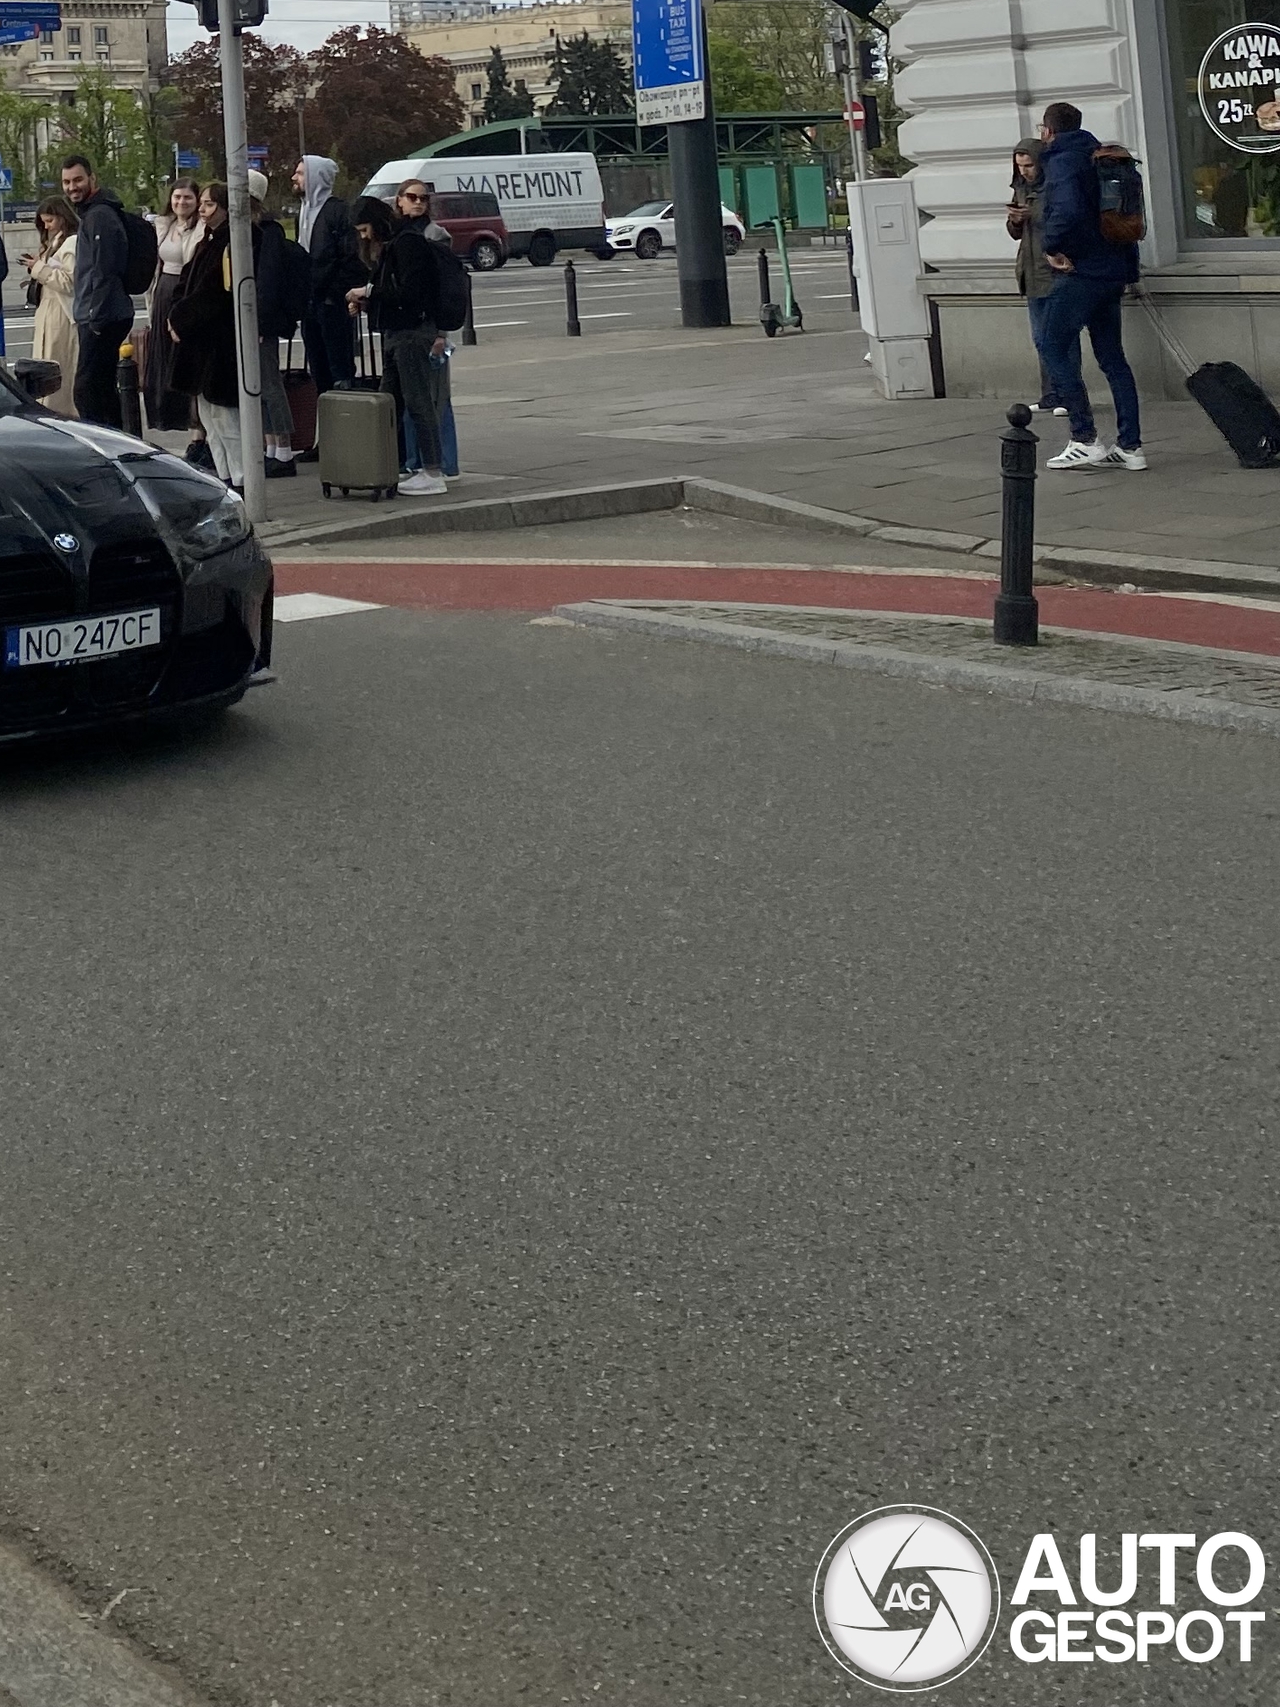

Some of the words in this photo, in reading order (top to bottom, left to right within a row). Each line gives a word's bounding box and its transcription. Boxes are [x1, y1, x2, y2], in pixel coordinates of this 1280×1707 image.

[670, 5, 685, 16] BUS
[669, 17, 686, 29] TAXI
[1224, 35, 1280, 60] KAWA
[1248, 52, 1264, 68] &
[456, 170, 582, 200] MAREMONT
[26, 627, 62, 662] NO
[73, 613, 153, 654] 247CF
